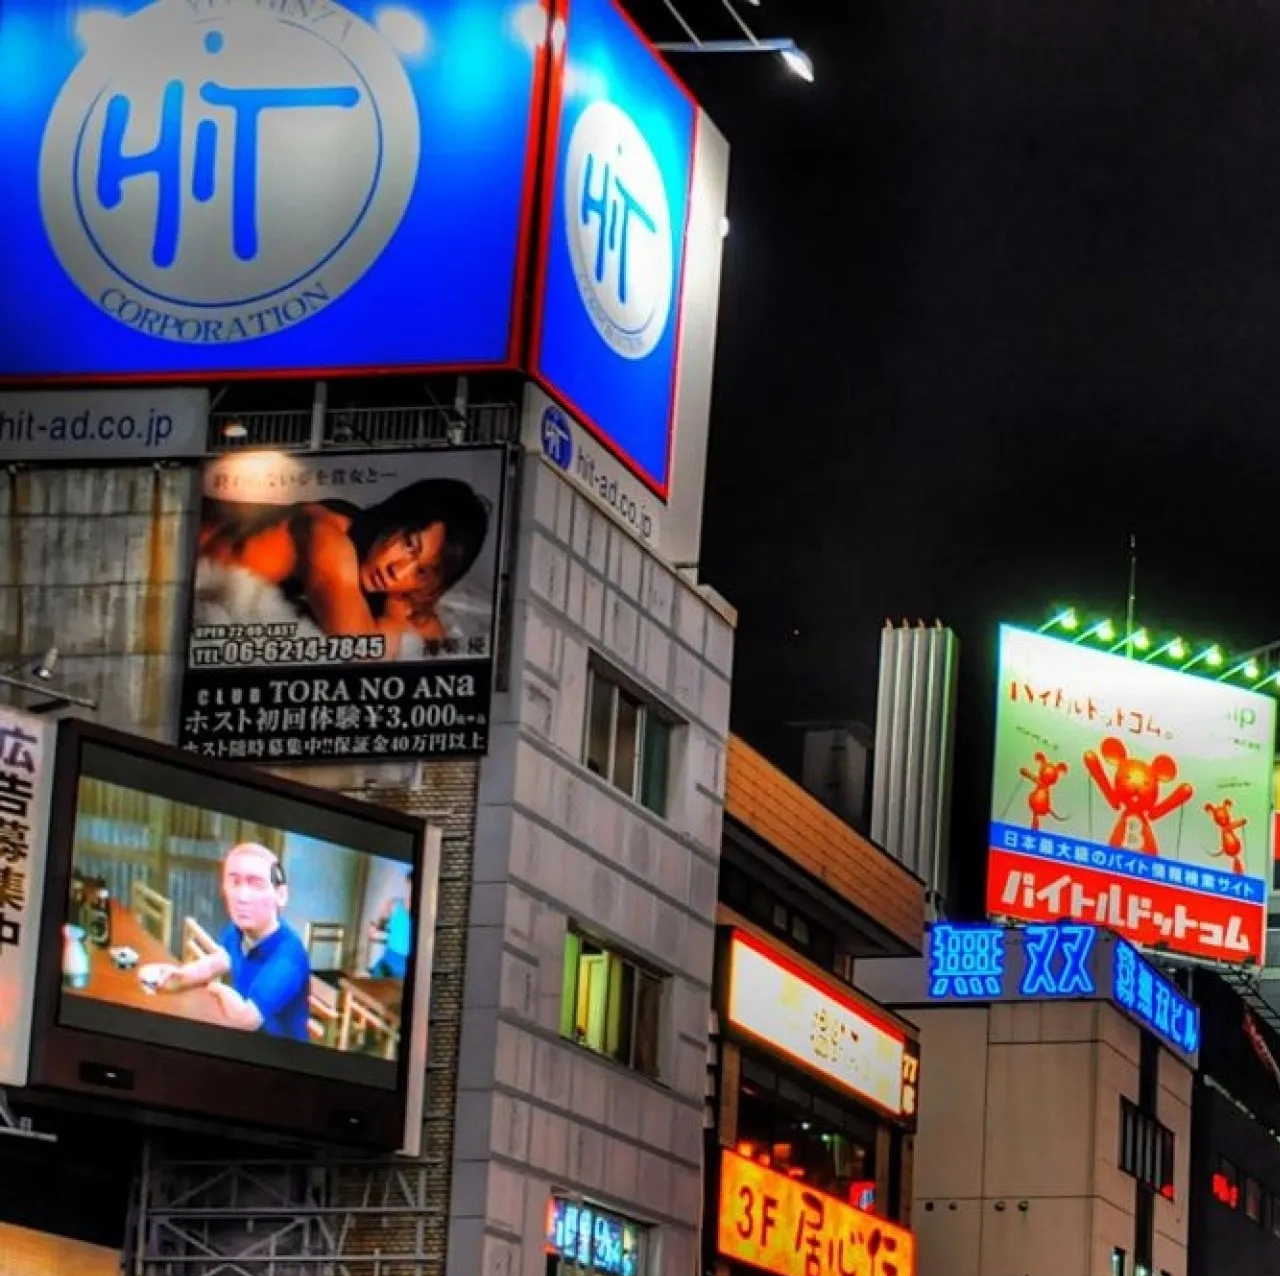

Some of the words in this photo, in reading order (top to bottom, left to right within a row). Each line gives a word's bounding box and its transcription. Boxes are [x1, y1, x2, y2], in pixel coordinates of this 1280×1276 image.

[100, 282, 330, 342] CORPORATION
[269, 678, 350, 704] TORA
[360, 677, 404, 701] NO
[1002, 869, 1250, 951] バイトルドットコム
[737, 1186, 780, 1247] 3F
